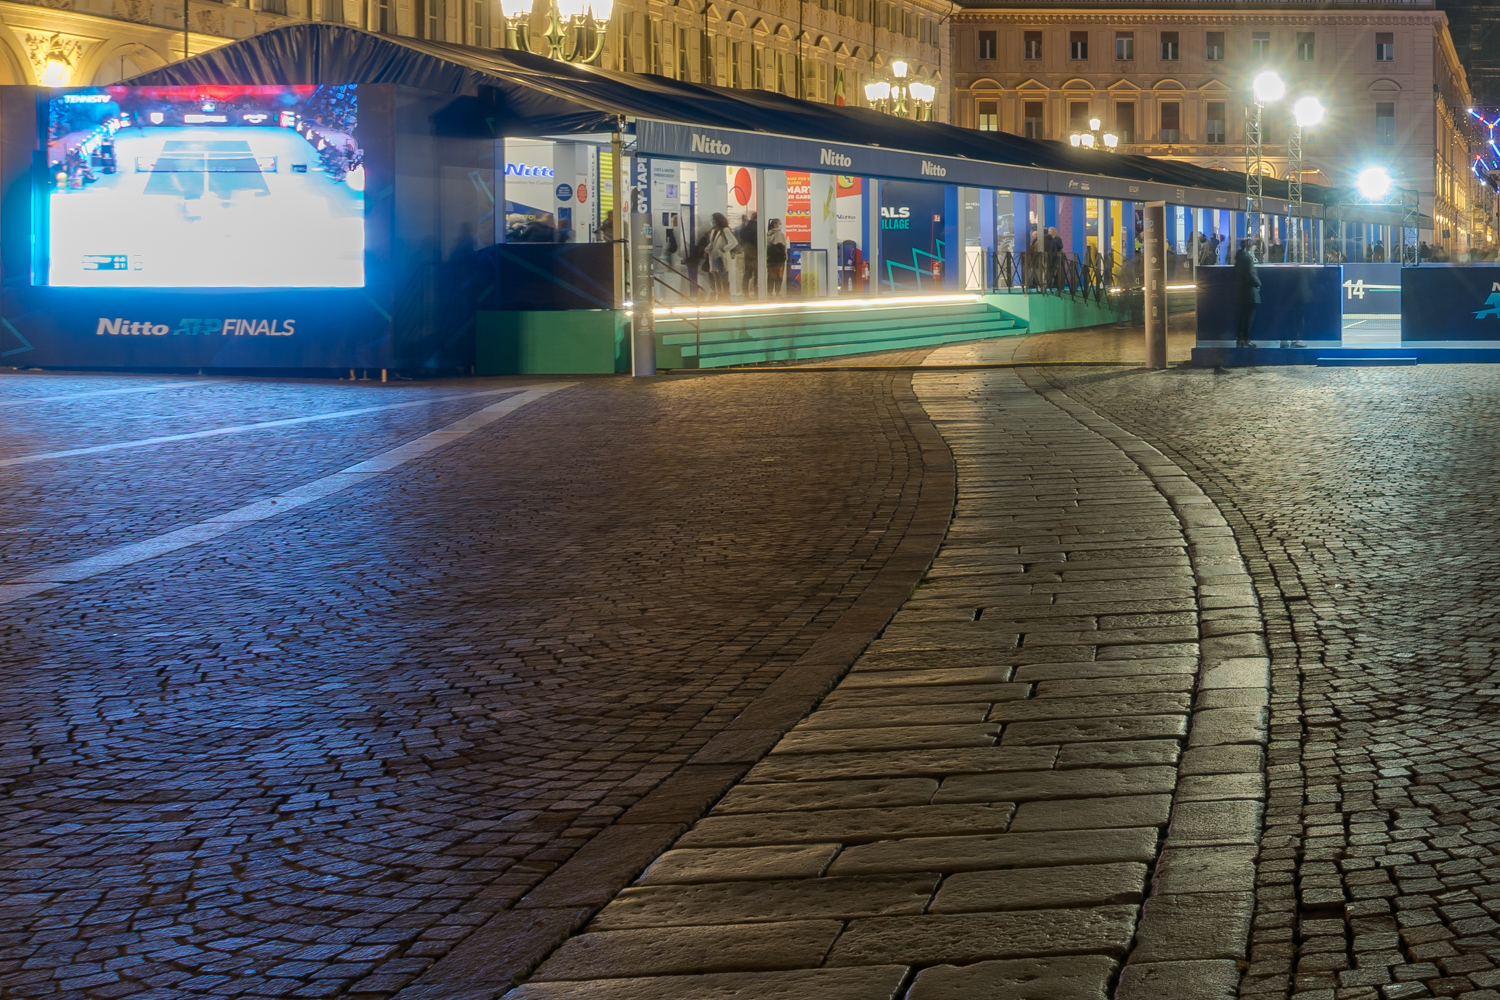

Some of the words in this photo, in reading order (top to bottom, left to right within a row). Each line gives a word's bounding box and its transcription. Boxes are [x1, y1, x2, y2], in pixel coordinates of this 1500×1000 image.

[691, 133, 731, 155] Nitto
[820, 148, 852, 167] Nitto
[921, 160, 947, 177] Nitto
[1343, 279, 1365, 300] 14
[96, 317, 170, 336] Nitto
[172, 318, 222, 336] ATP
[222, 318, 295, 336] FINALS
